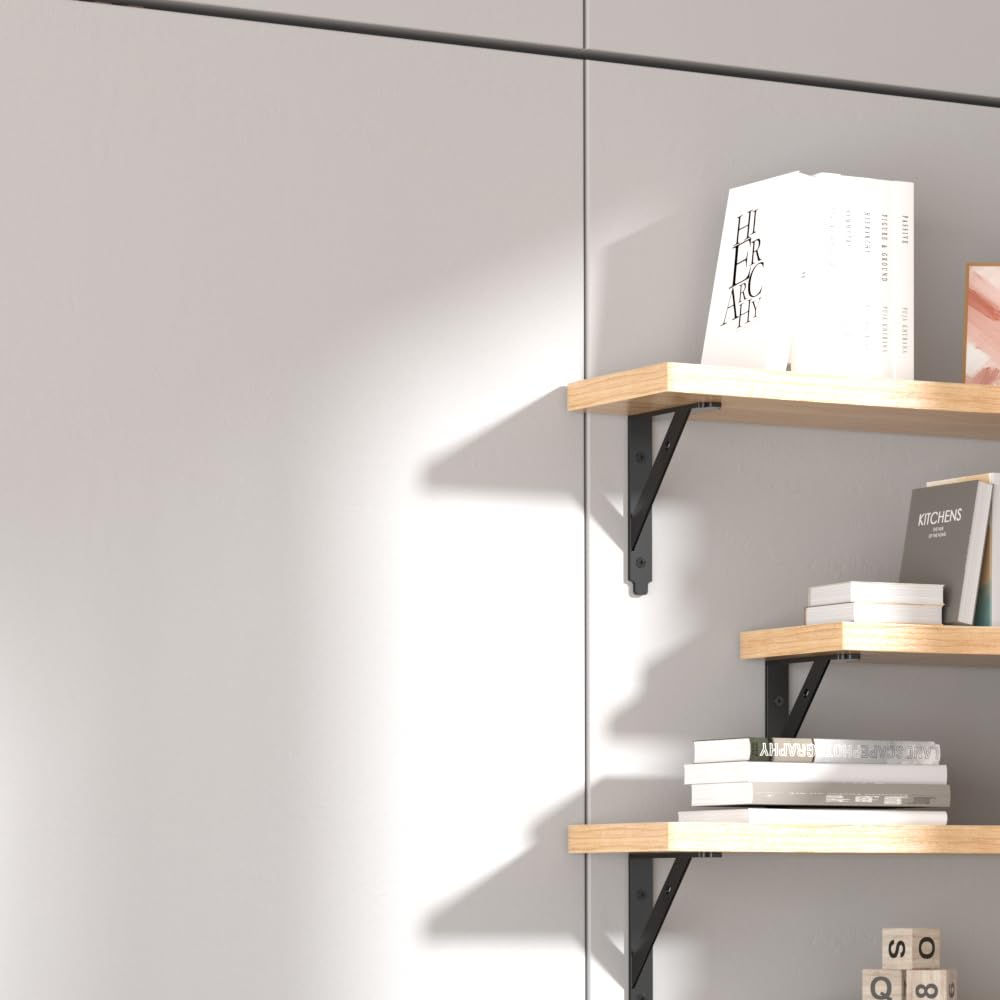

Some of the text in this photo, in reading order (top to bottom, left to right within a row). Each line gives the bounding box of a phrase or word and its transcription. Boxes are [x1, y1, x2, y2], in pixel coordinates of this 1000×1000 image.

[917, 507, 963, 527] KITCHENS
[888, 939, 906, 959] S
[918, 936, 936, 960] O
[915, 983, 939, 999] 8
